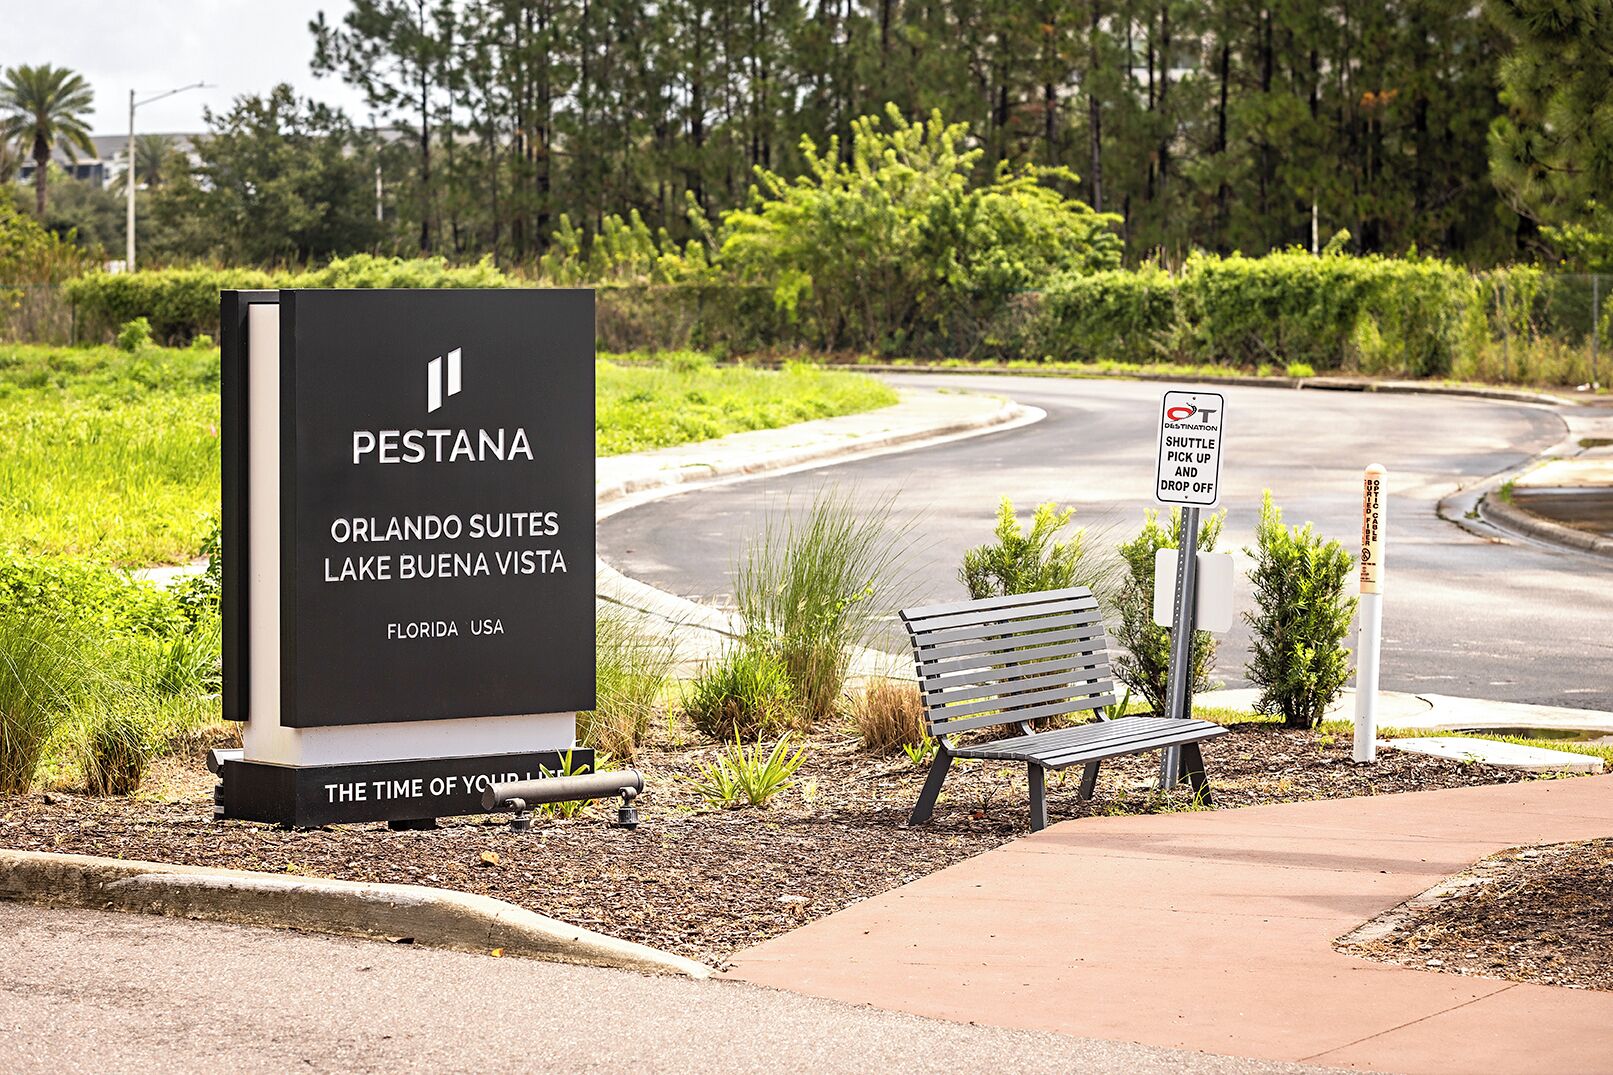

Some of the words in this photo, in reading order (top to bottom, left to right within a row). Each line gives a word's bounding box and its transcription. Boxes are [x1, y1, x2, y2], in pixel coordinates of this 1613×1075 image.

[1164, 423, 1218, 431] DESTINATION
[352, 427, 535, 465] PESTANA
[1165, 436, 1215, 449] SHUTTLE
[1167, 451, 1193, 463] PICK
[1196, 453, 1211, 464] UP
[1174, 466, 1198, 478] AND
[1160, 480, 1190, 492] DROP
[1192, 482, 1213, 493] OFF
[330, 514, 463, 543] ORLANDO
[468, 511, 560, 539] SUITES
[324, 555, 392, 582] LAKE
[399, 552, 491, 579] BUENA
[495, 549, 567, 576] VISTA
[387, 621, 459, 640] FLORIDA
[470, 618, 504, 636] USA
[324, 781, 367, 803] THE
[372, 778, 424, 801] TIME
[429, 775, 457, 797] OF
